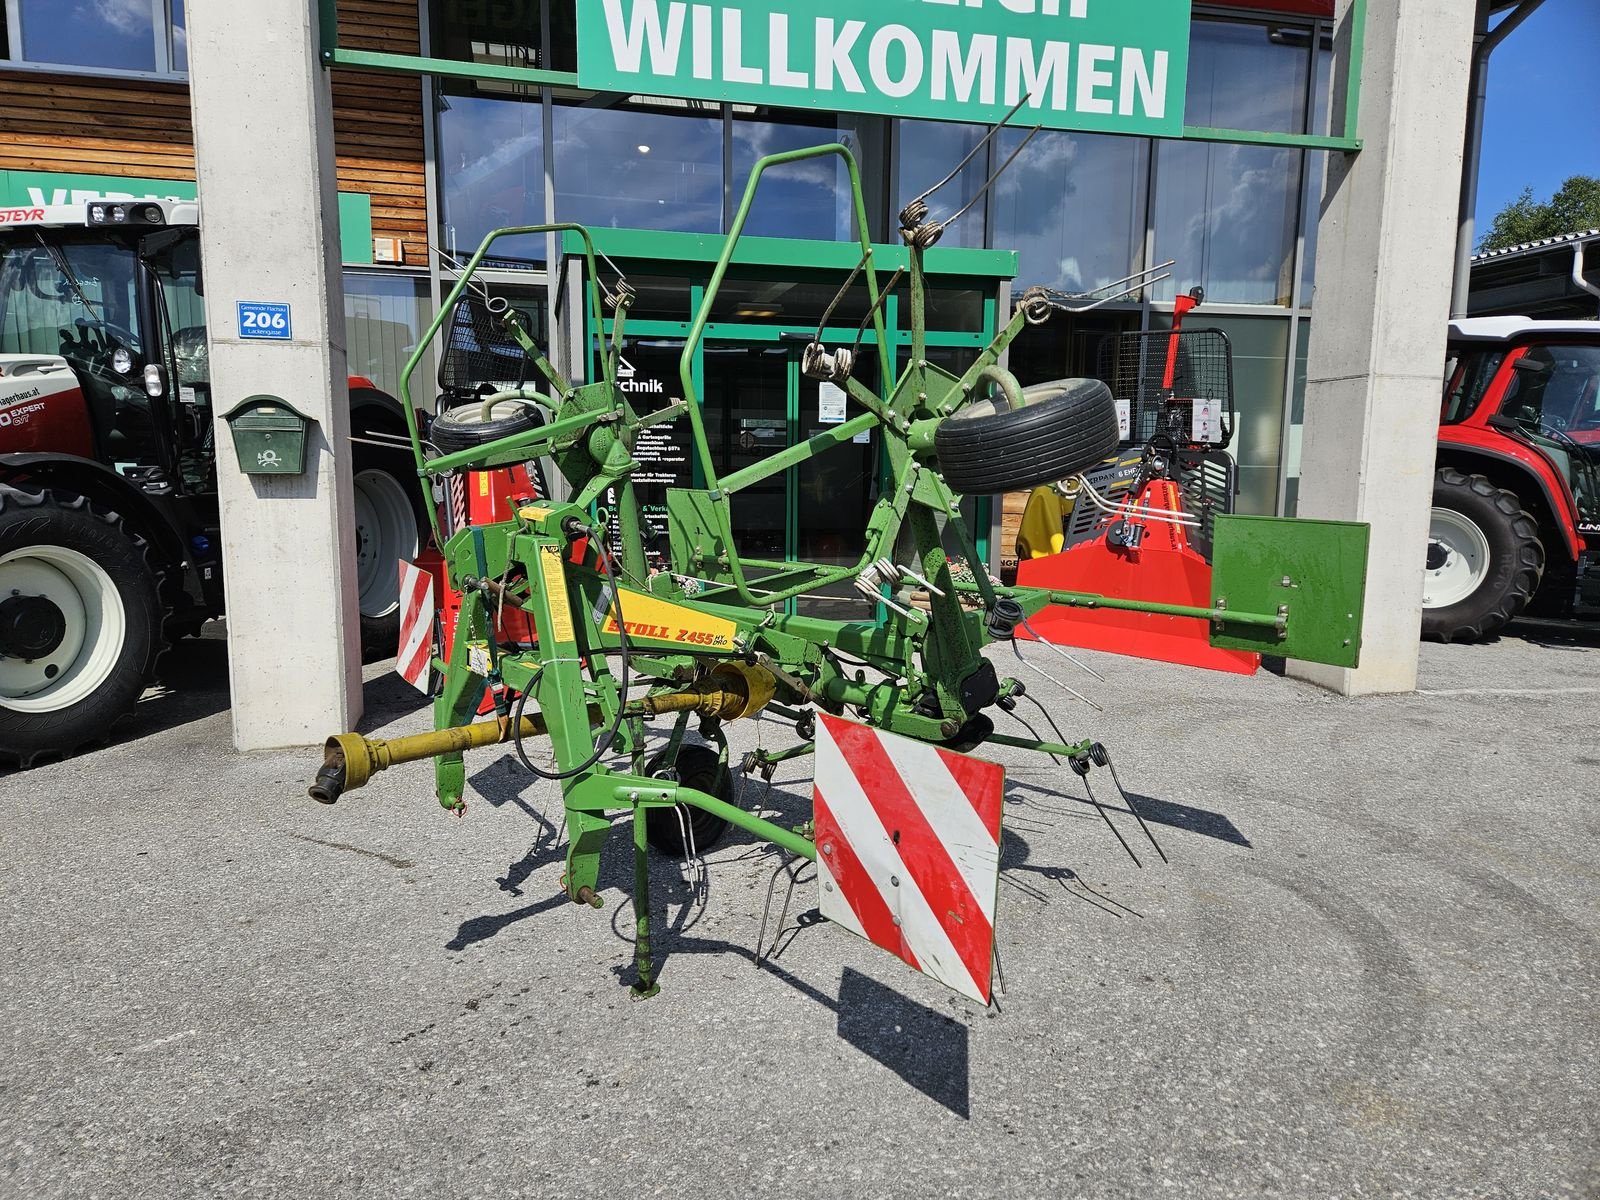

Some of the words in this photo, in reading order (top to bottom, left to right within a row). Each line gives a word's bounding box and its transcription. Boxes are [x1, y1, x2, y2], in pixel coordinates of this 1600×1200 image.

[603, 0, 1168, 118] WILLKOMMEN
[0, 209, 45, 222] STEYR
[243, 311, 286, 329] 206
[247, 328, 282, 336] Lackengasse
[615, 379, 663, 393] chnik
[10, 402, 45, 417] EXPERT
[607, 620, 670, 639] STOLL
[675, 629, 714, 645] Z455
